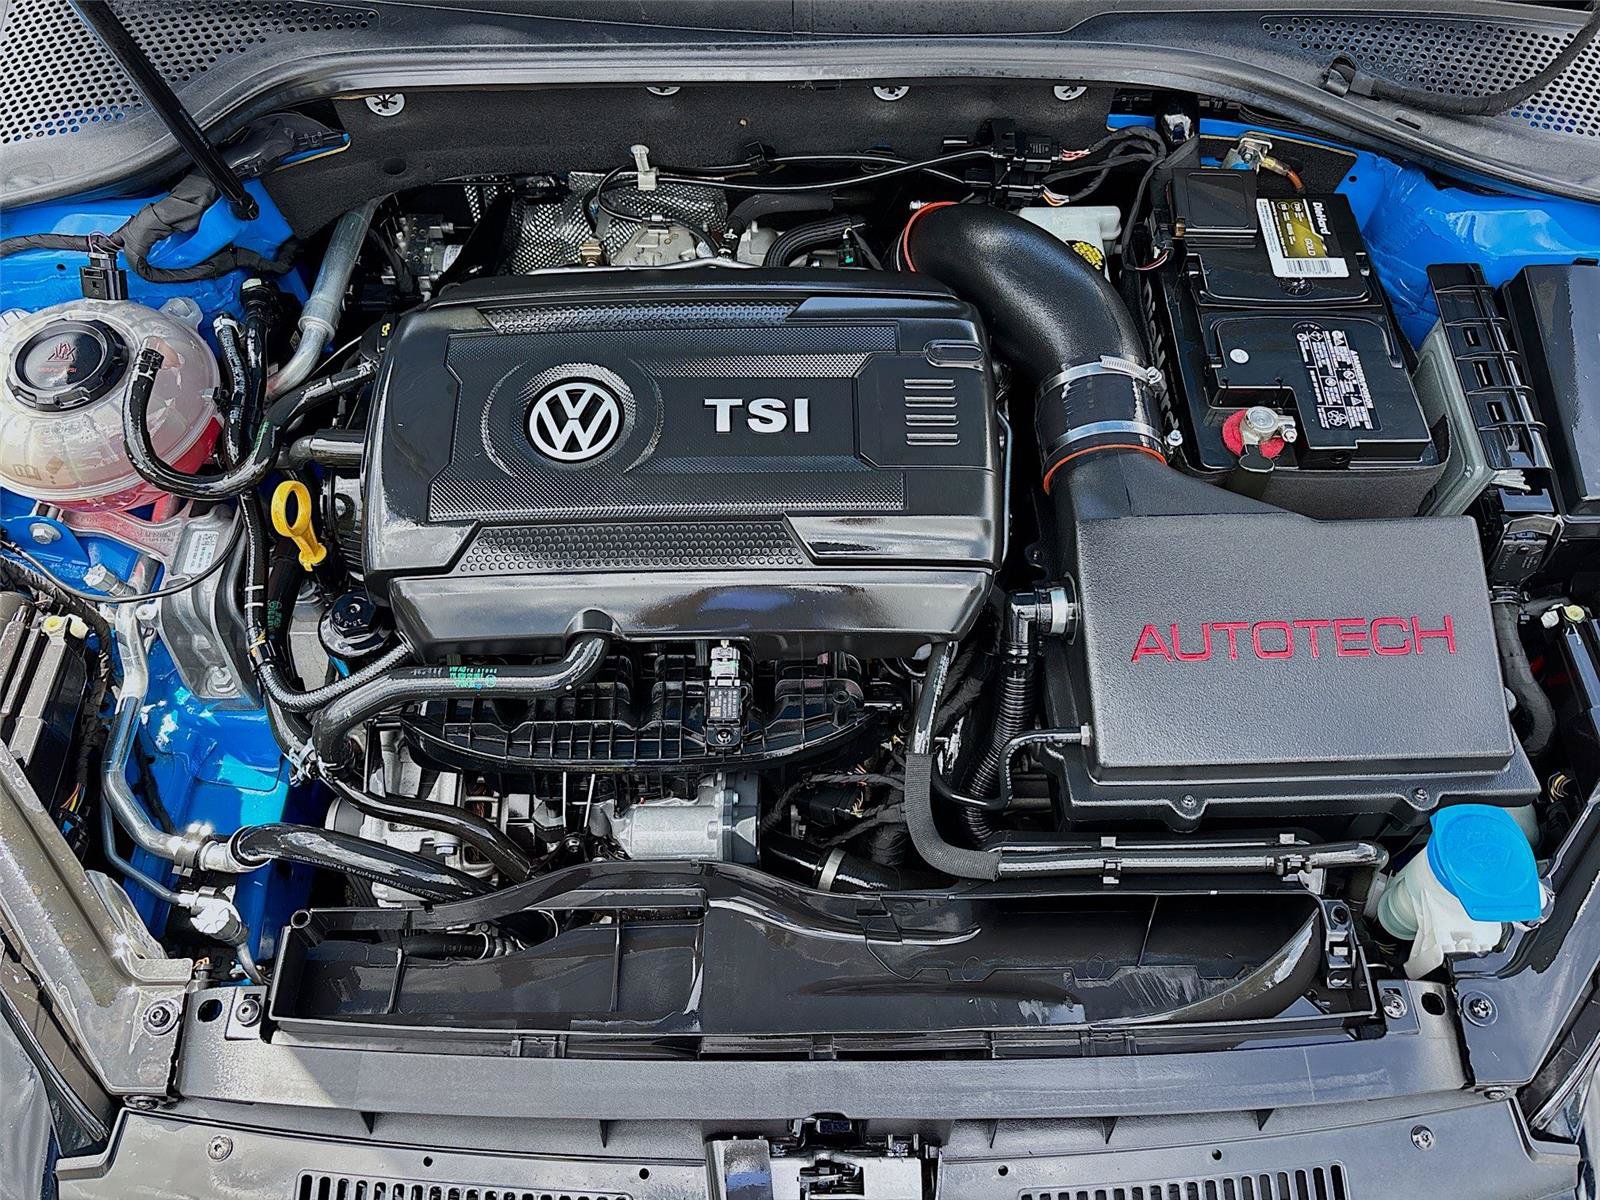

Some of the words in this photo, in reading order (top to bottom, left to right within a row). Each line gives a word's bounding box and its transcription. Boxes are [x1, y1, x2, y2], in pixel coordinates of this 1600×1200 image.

[1312, 202, 1331, 235] DieHard
[1304, 238, 1316, 256] GOLD
[529, 382, 620, 461] VW
[704, 398, 810, 433] TSI
[1131, 614, 1457, 663] AUTOTECH
